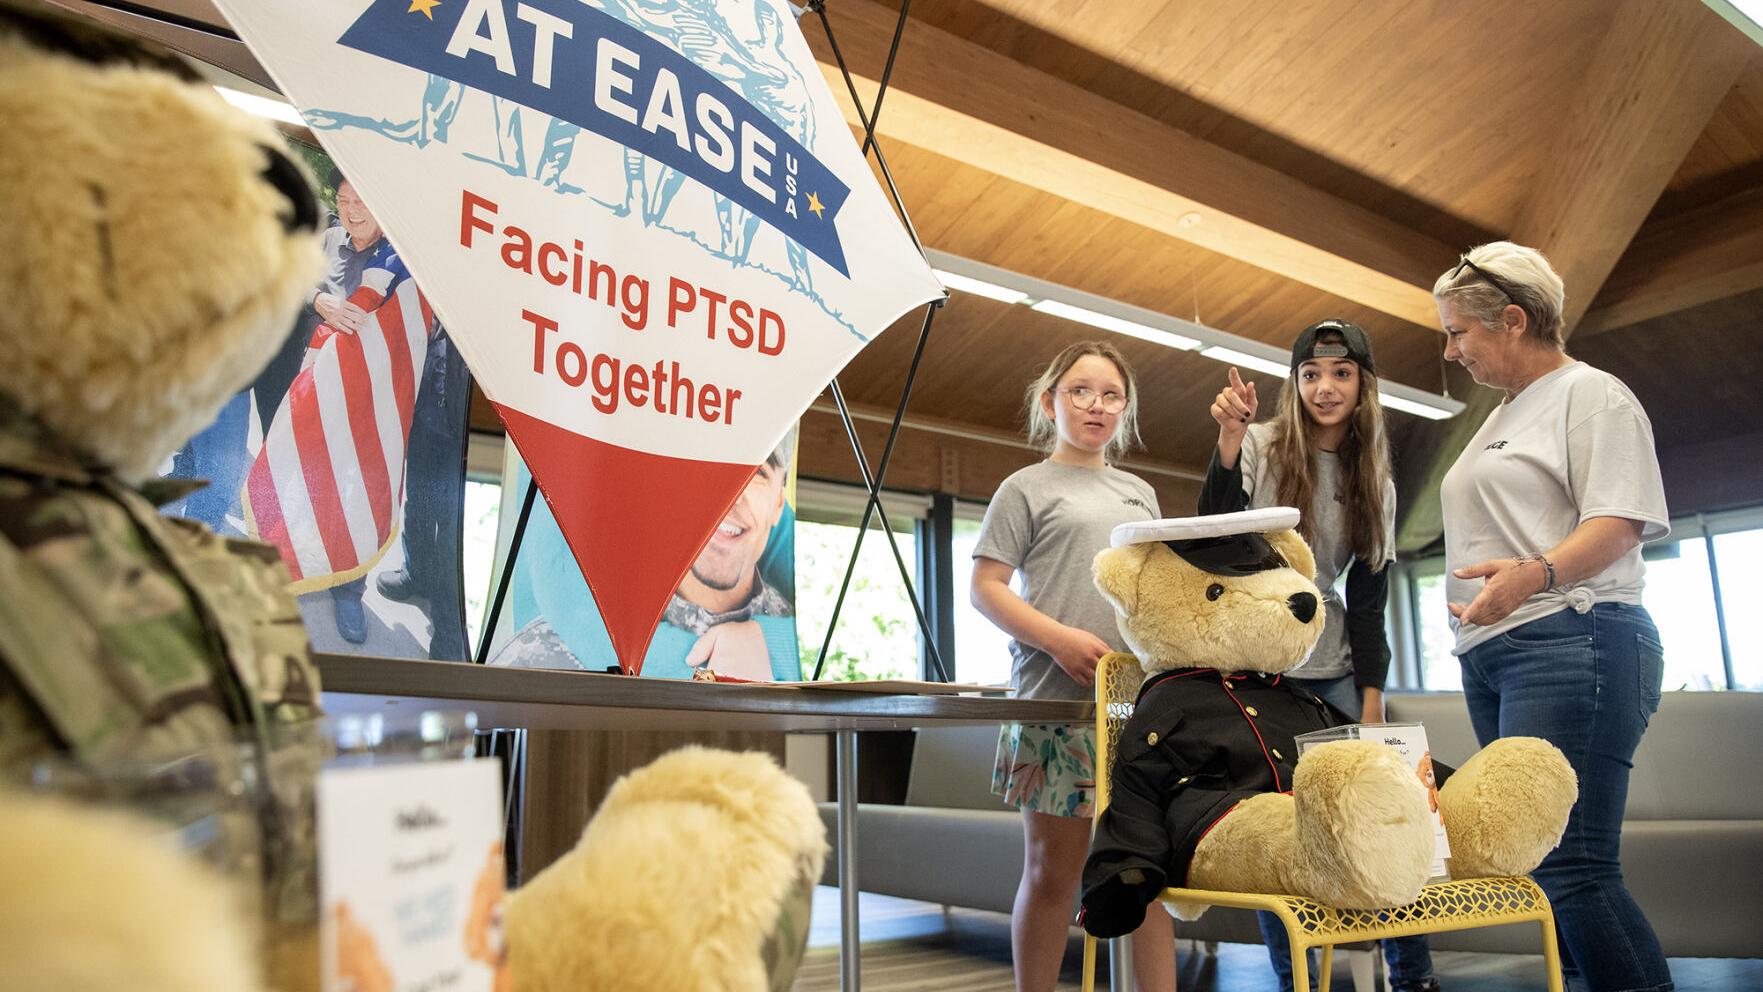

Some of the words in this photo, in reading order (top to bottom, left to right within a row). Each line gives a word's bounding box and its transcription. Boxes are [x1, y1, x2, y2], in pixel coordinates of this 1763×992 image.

[444, 0, 574, 90] AT
[594, 37, 777, 205] EASE
[784, 151, 798, 220] USA
[460, 190, 649, 331] Facing
[667, 277, 786, 356] PTSD
[522, 309, 742, 425] Together
